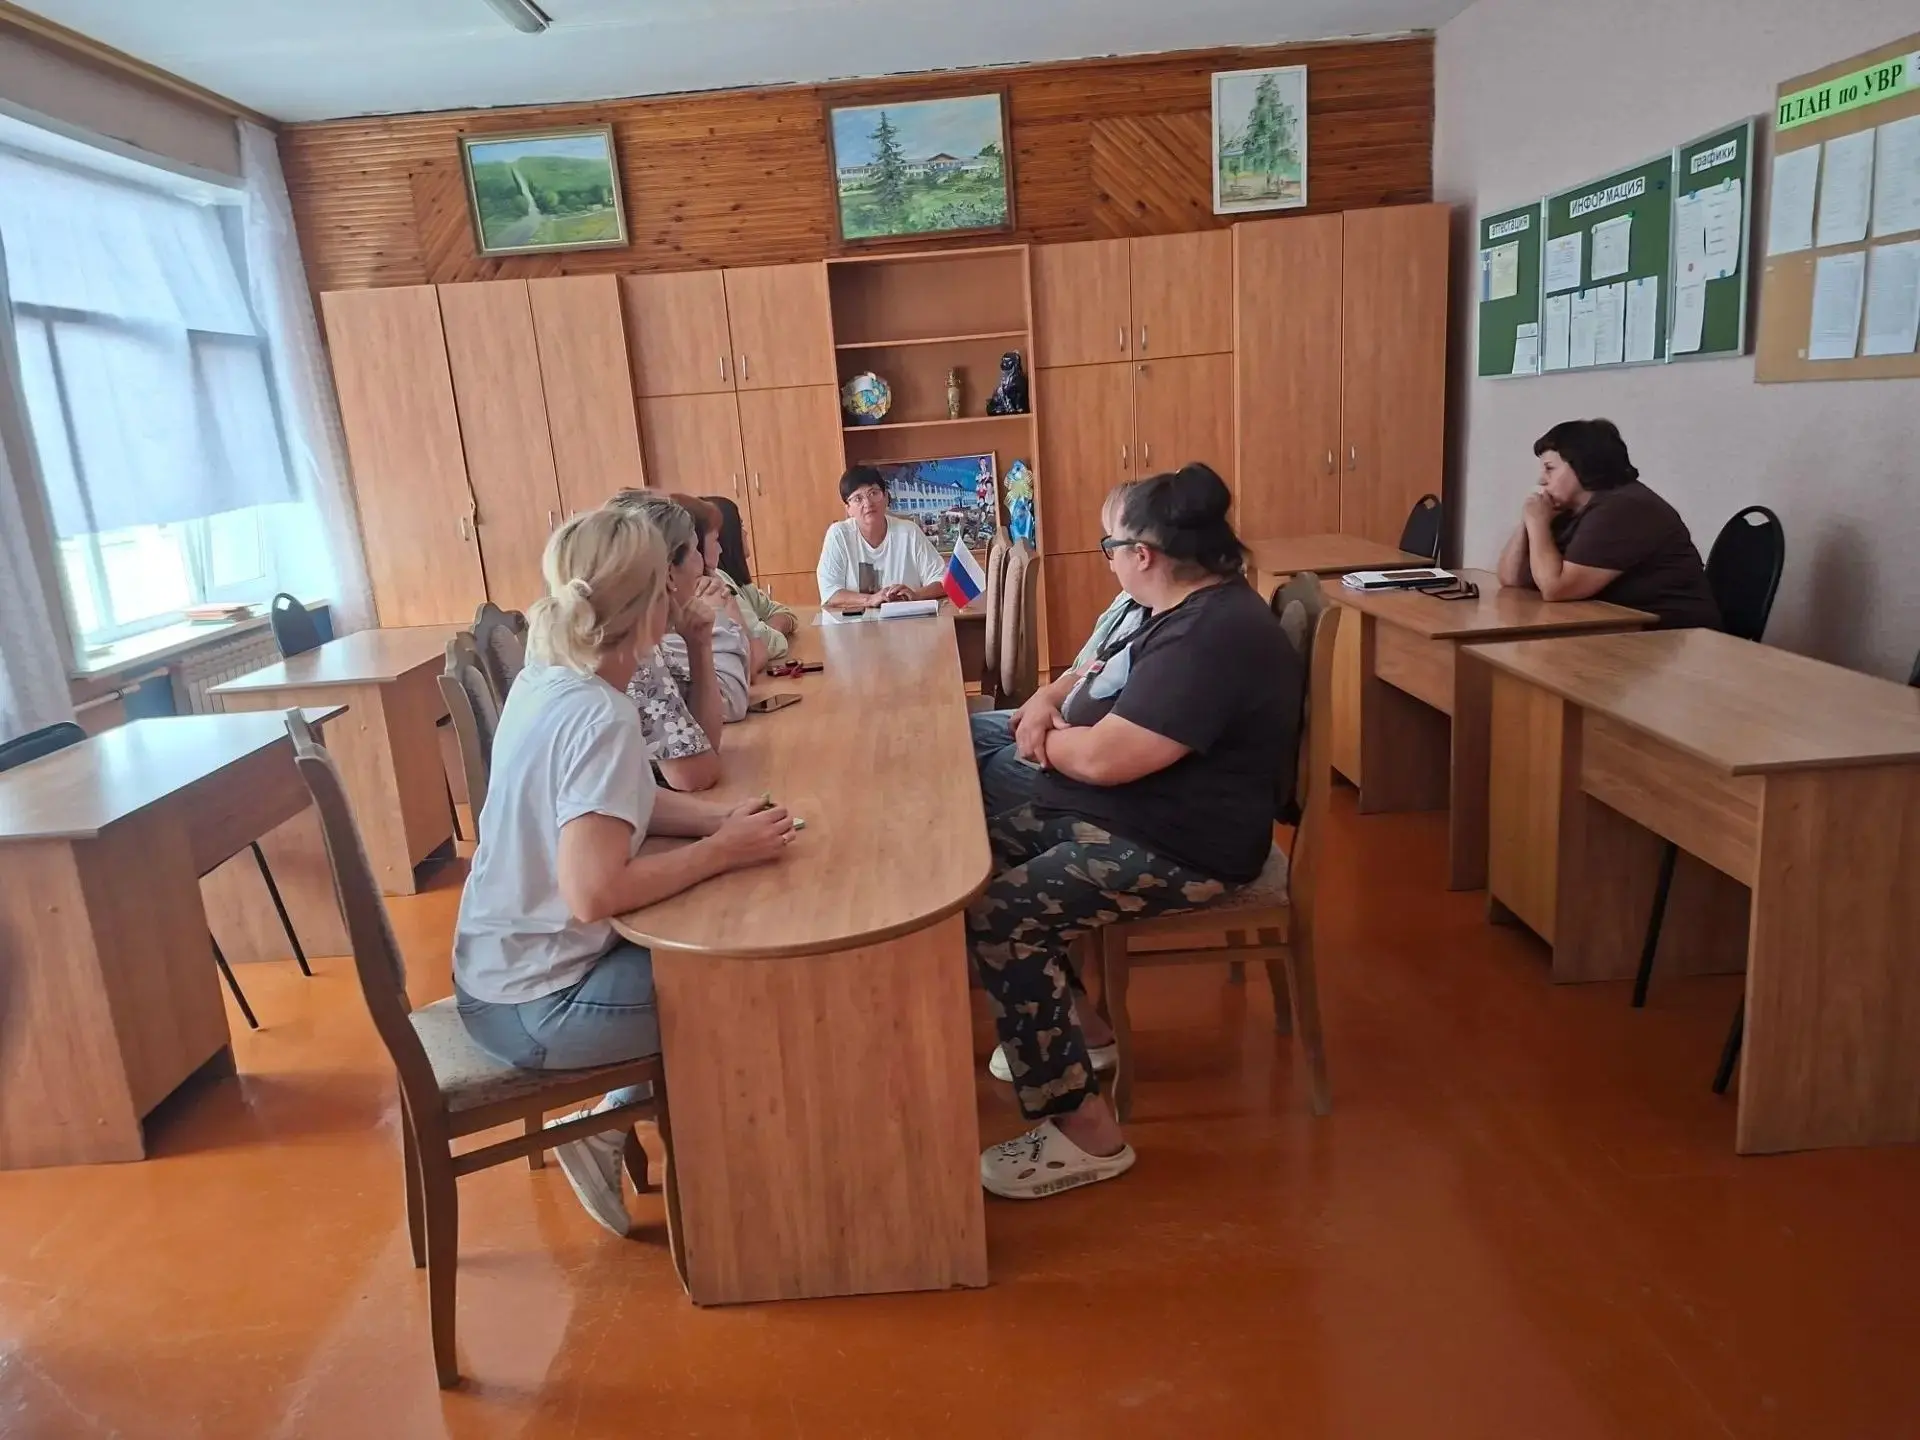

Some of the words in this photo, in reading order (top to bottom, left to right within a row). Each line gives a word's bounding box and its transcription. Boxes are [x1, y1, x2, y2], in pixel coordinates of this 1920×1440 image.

[1780, 88, 1831, 124] ПЛАН
[1839, 85, 1858, 104] по
[1864, 64, 1902, 96] УВР
[1572, 179, 1643, 216] ИНФОРМАЦИЯ
